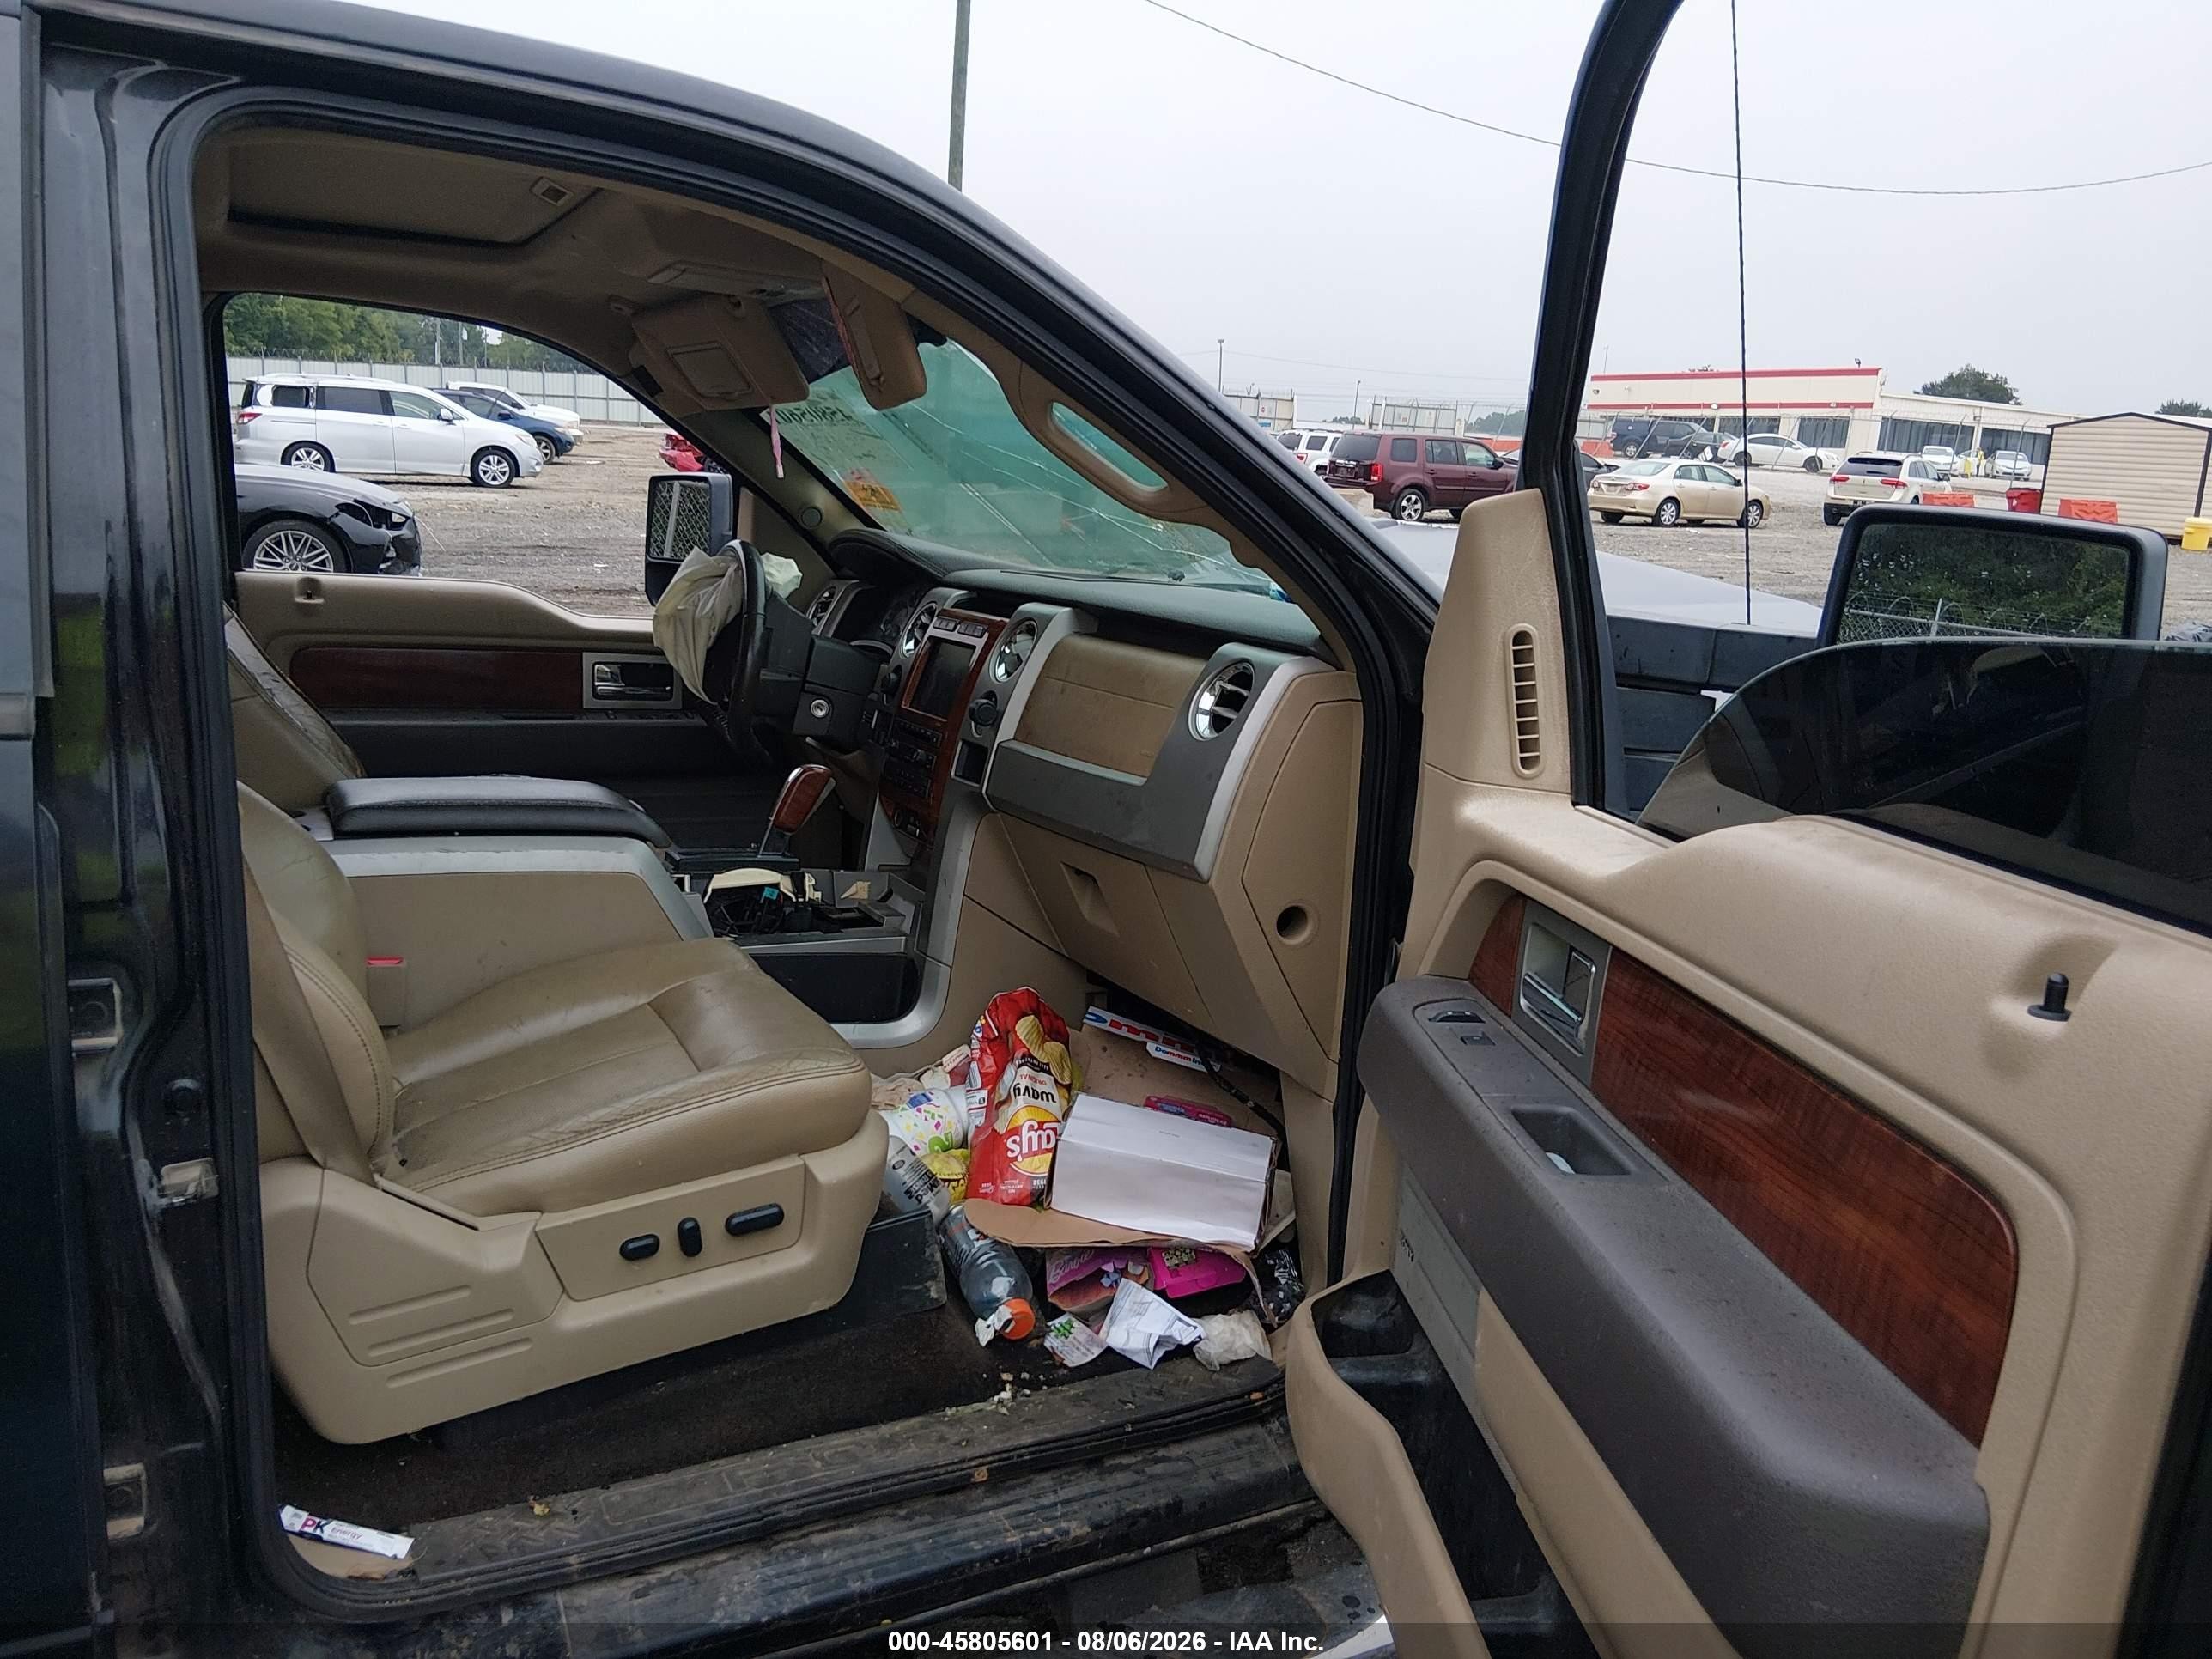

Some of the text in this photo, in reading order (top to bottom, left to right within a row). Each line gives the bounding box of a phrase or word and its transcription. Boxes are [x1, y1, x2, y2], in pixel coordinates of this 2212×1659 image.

[1012, 1082, 1057, 1103] wavy
[300, 1516, 334, 1534] PK
[331, 1526, 364, 1540] Energy
